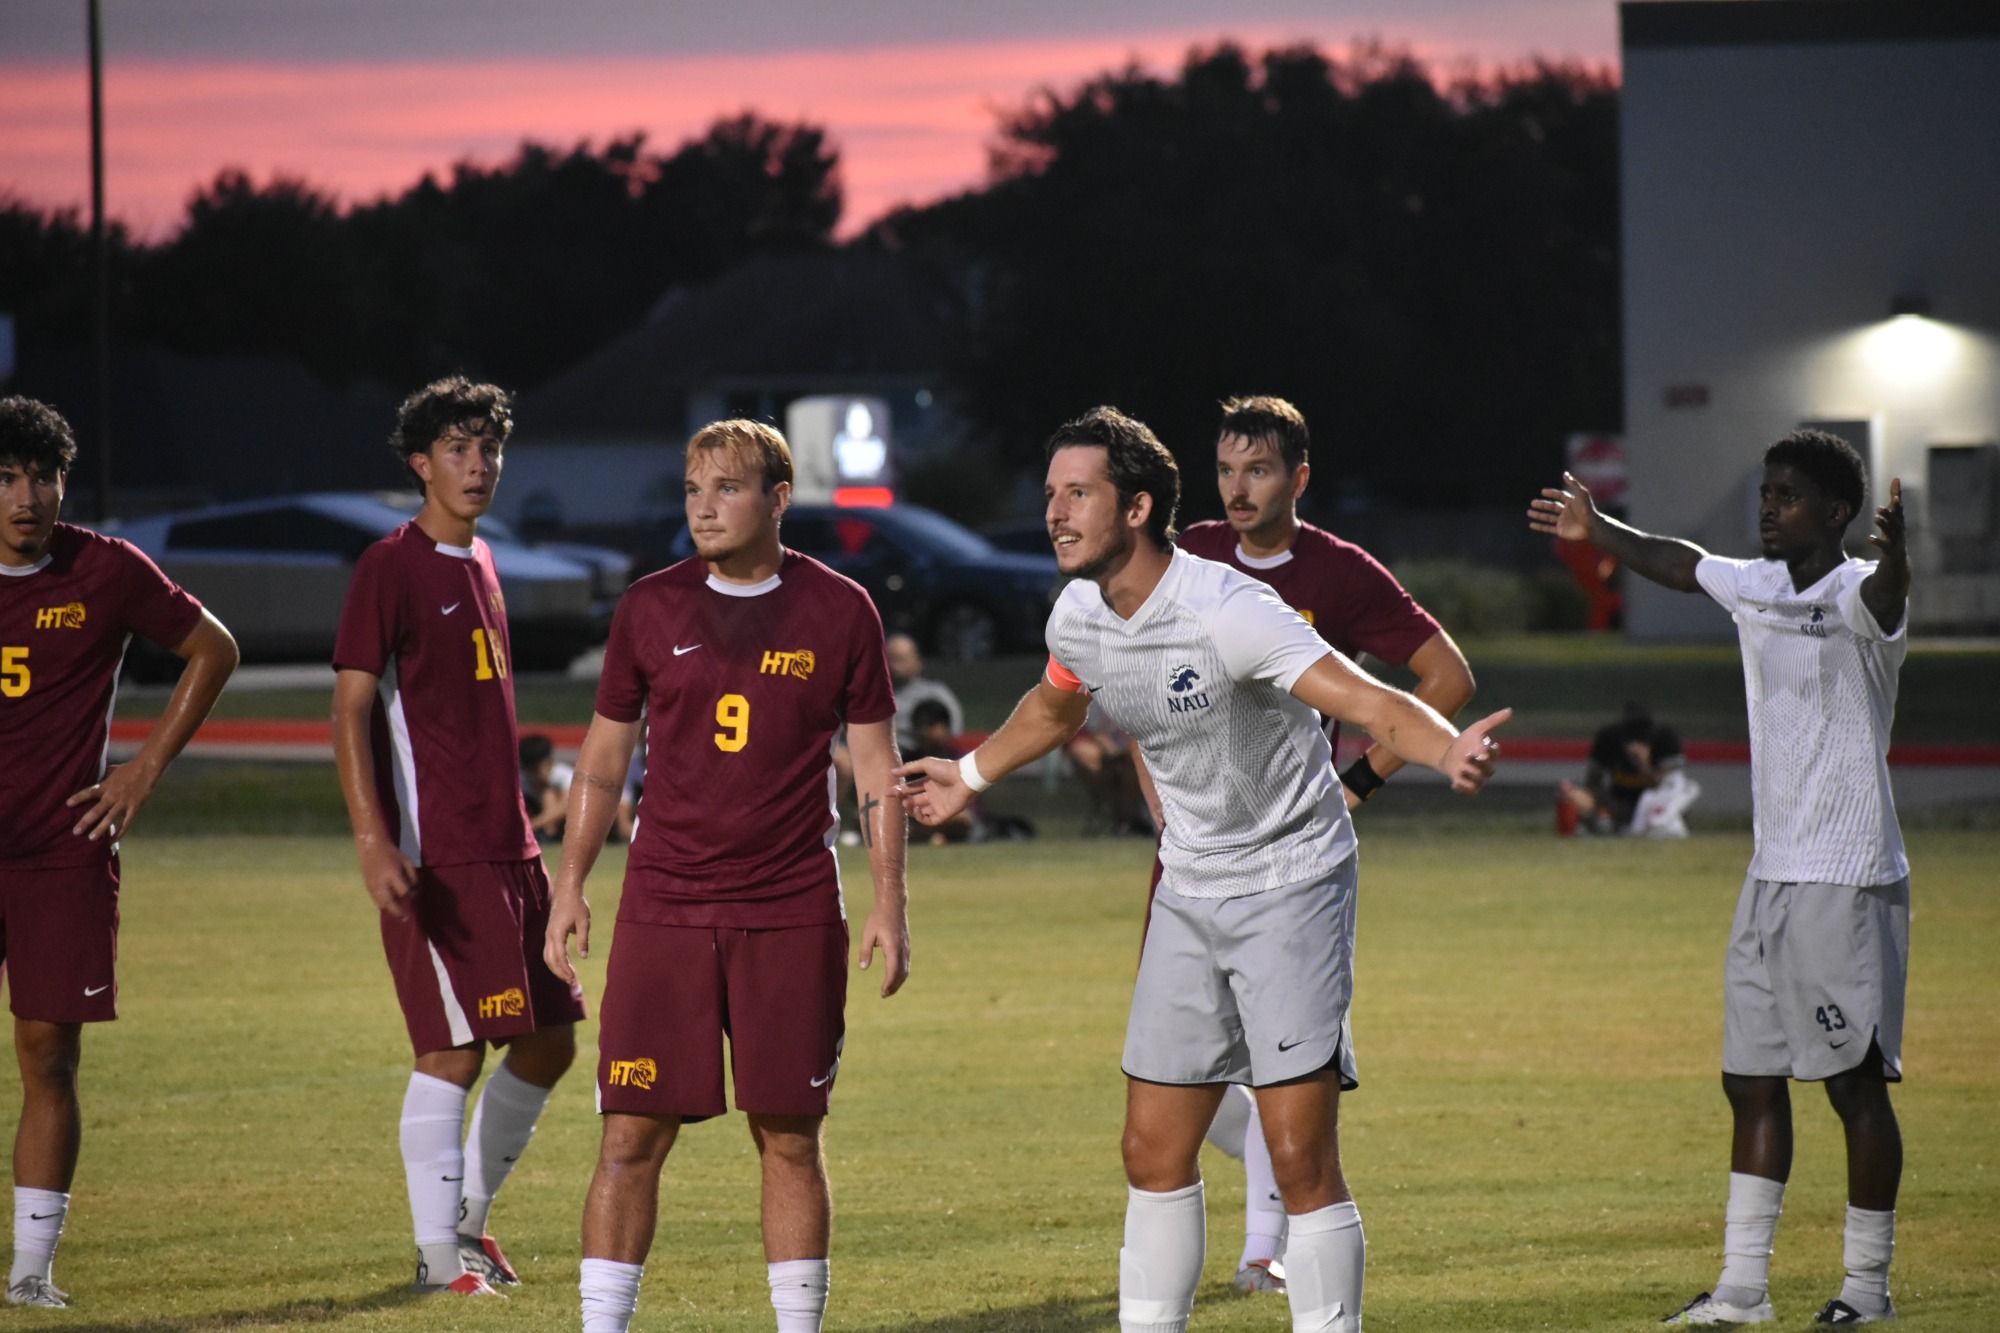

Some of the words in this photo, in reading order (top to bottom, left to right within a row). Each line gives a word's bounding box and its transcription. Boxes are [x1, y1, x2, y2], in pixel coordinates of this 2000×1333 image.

[35, 607, 67, 629] HT
[1801, 624, 1826, 638] NAU
[0, 646, 30, 697] 5
[760, 651, 796, 675] HT
[1167, 693, 1209, 712] NAU
[714, 693, 750, 752] 9
[479, 995, 505, 1018] HT
[1816, 1004, 1846, 1032] 43
[609, 1061, 635, 1086] HT
